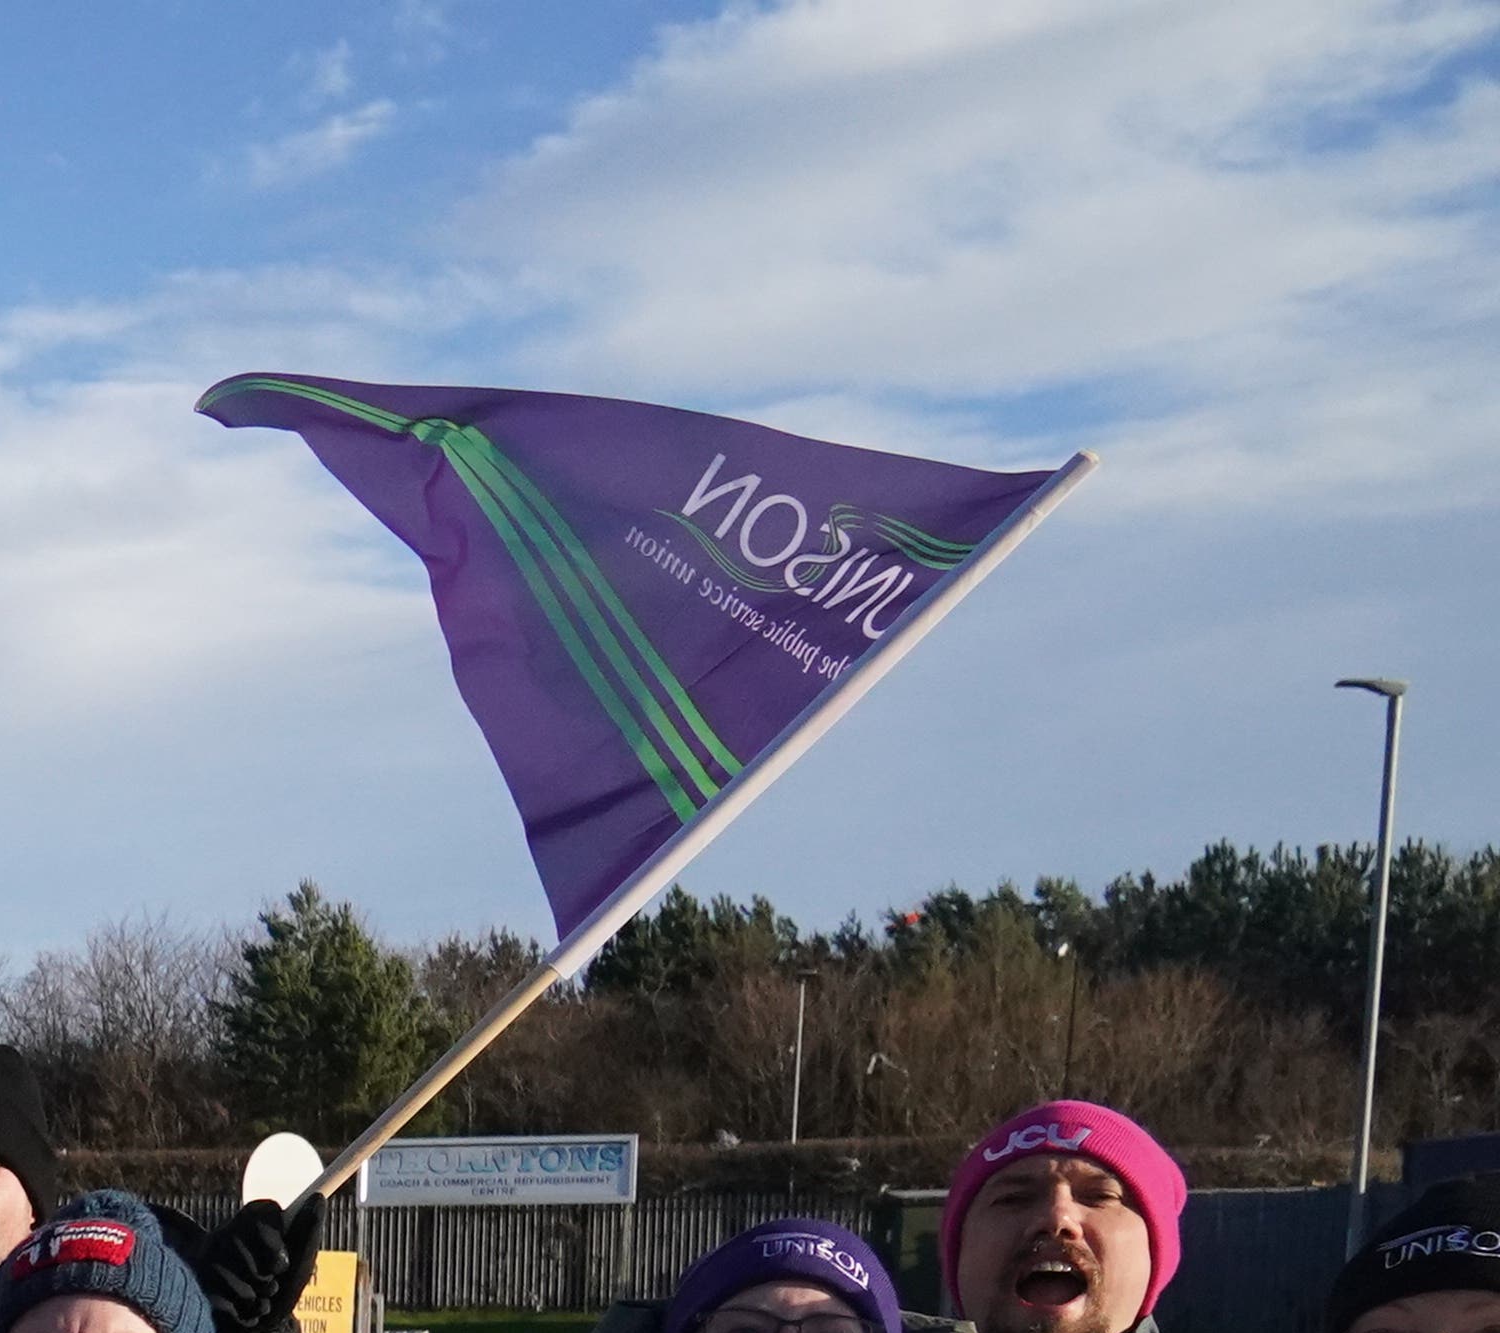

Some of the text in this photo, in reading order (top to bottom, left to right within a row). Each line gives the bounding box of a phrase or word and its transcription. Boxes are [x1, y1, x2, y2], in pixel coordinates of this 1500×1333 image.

[373, 1144, 624, 1175] THORNTONS
[380, 1178, 420, 1188] COACH
[434, 1178, 508, 1187] COMMERCIAL
[514, 1176, 611, 1186] REFURBISHMENT
[471, 1188, 516, 1196] CENTRE
[762, 1235, 870, 1287] UNISON
[297, 1296, 342, 1313] EHICLES
